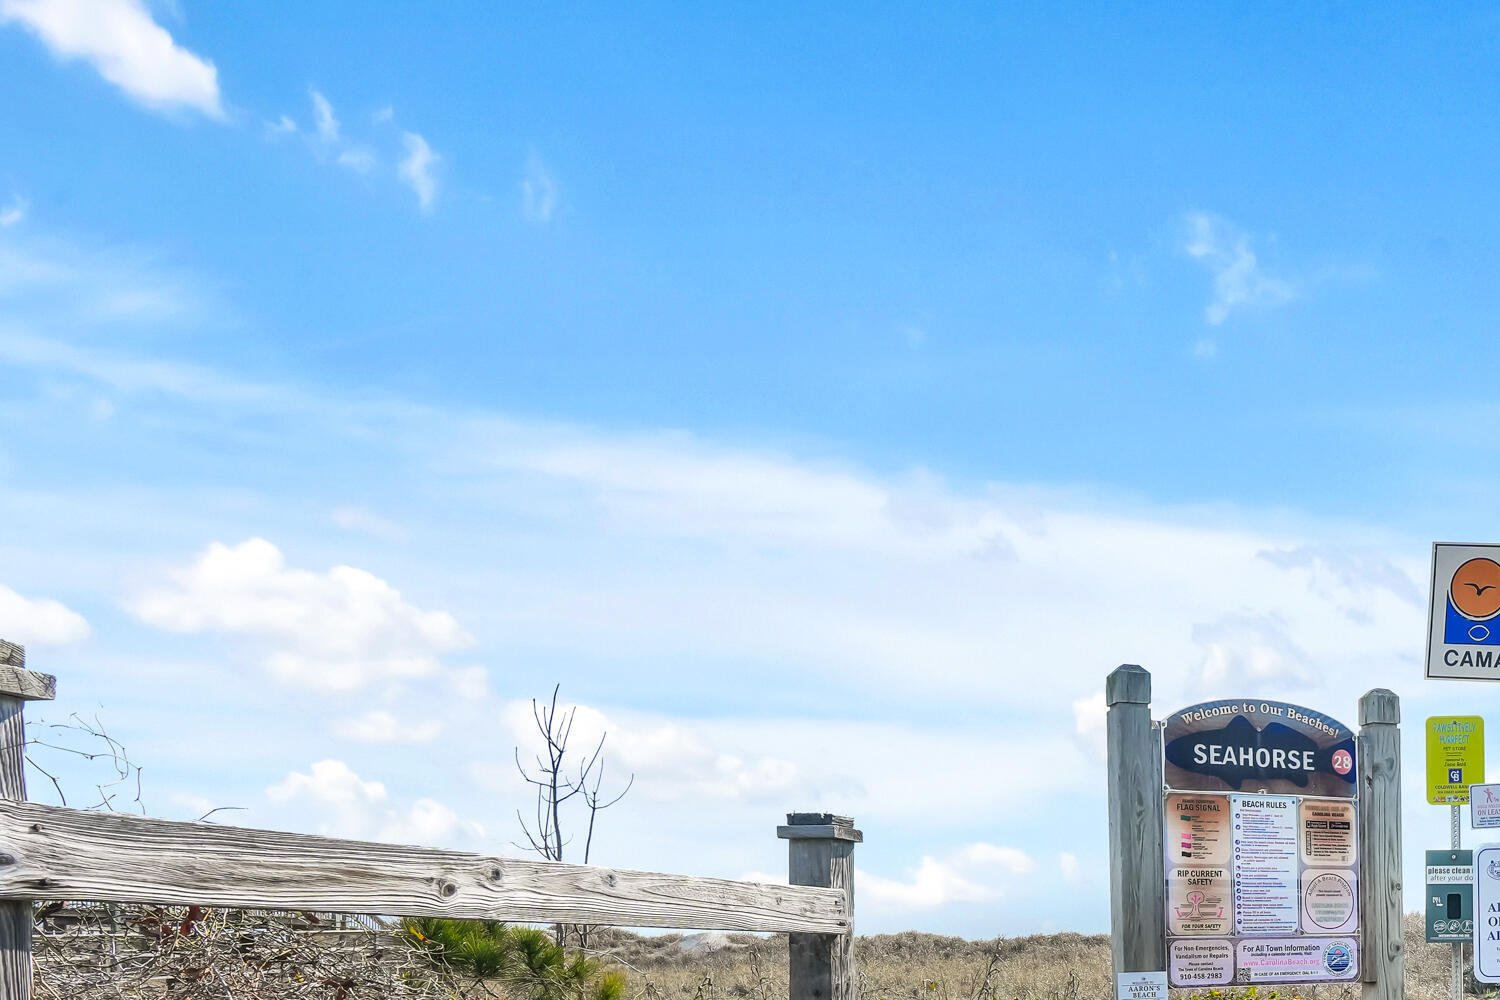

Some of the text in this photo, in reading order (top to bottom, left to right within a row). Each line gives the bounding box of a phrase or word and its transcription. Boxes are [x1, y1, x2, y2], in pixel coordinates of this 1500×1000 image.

[1180, 702, 1340, 739] Welcome to Our Beaches!
[1193, 743, 1316, 771] SEAHORSE
[1333, 755, 1352, 770] 28
[1176, 803, 1221, 812] FLAG SIGNAL
[1242, 800, 1287, 809] BEACH RULES
[1191, 870, 1222, 878] CURRENT
[1187, 878, 1213, 886] SAFETY
[1284, 944, 1320, 952] Information
[1243, 959, 1320, 967] www.CarolinaBeach.org
